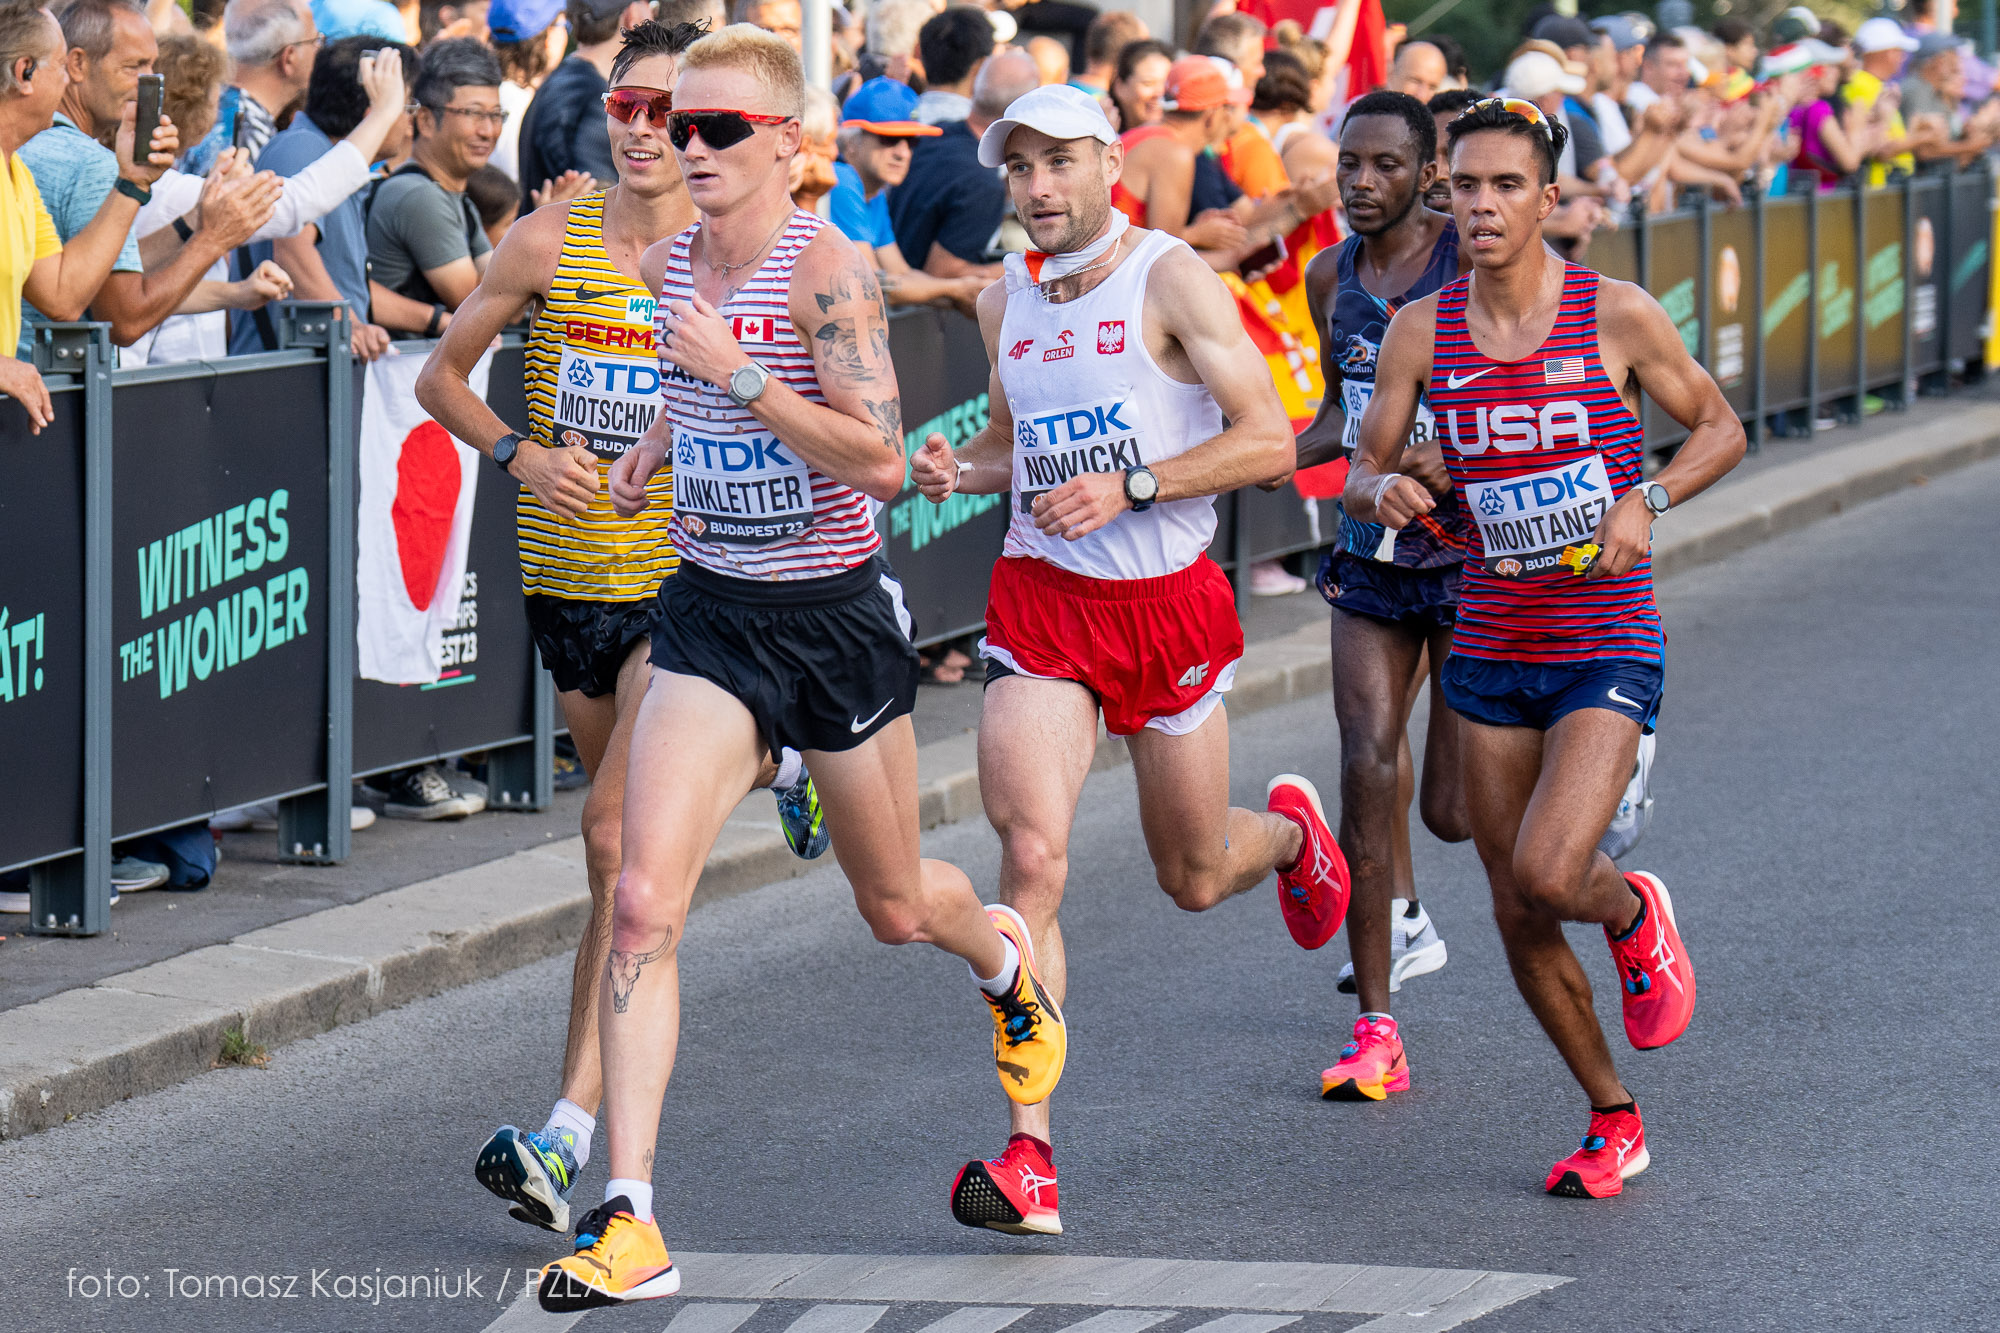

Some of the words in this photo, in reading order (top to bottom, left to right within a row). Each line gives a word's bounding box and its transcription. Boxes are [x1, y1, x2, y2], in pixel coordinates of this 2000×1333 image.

[566, 320, 657, 351] GERM
[1008, 339, 1034, 360] 4F
[1044, 347, 1073, 361] ORLEN
[1033, 400, 1132, 445] TDK
[1447, 400, 1591, 455] USA
[693, 437, 793, 472] TDK
[1024, 437, 1142, 486] NOWICKI
[676, 473, 804, 514] LINKLETTER
[1500, 463, 1599, 511] TDK
[710, 521, 784, 537] BUDAPEST
[138, 488, 289, 620] WITNESS
[120, 632, 154, 682] THE
[157, 566, 309, 700] WONDER
[1177, 660, 1210, 687] 4F
